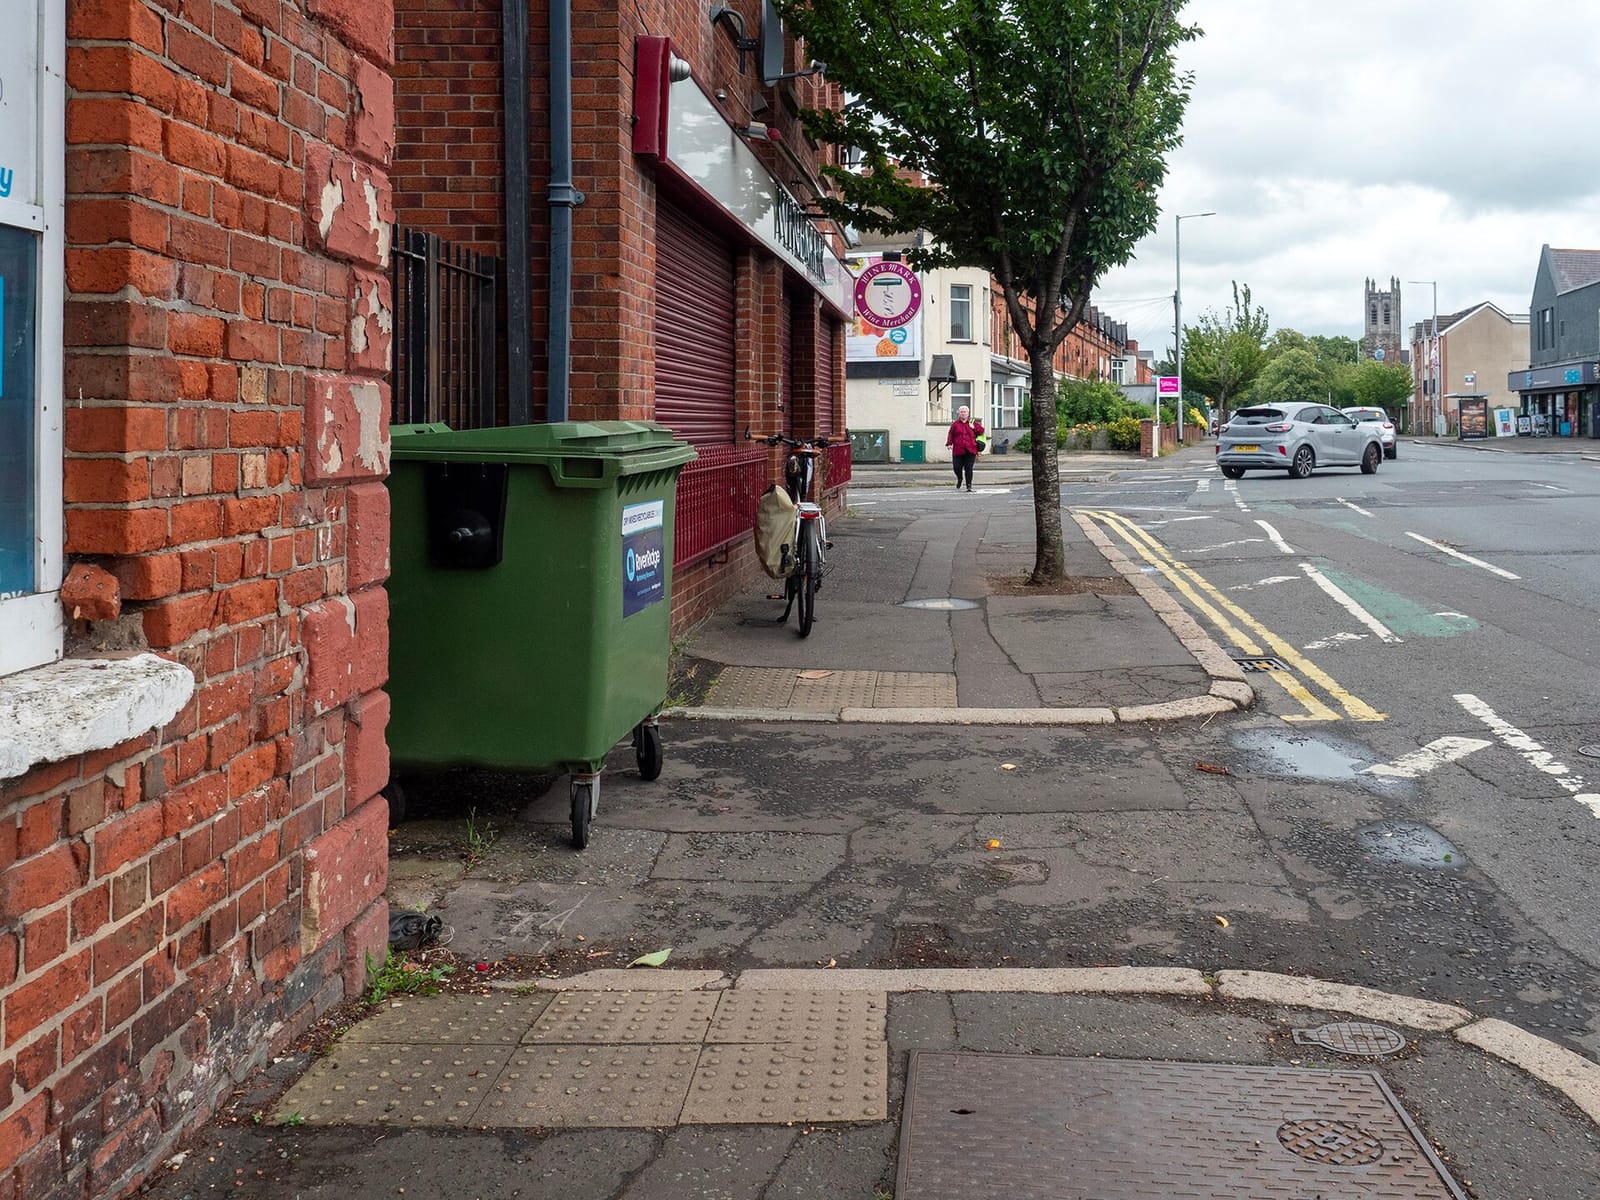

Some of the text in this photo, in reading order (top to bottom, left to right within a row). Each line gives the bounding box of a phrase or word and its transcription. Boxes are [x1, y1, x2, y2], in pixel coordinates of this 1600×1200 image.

[861, 264, 917, 284] WINEMARK
[863, 307, 916, 327] Wine Merchant
[635, 548, 660, 571] RiverRidge
